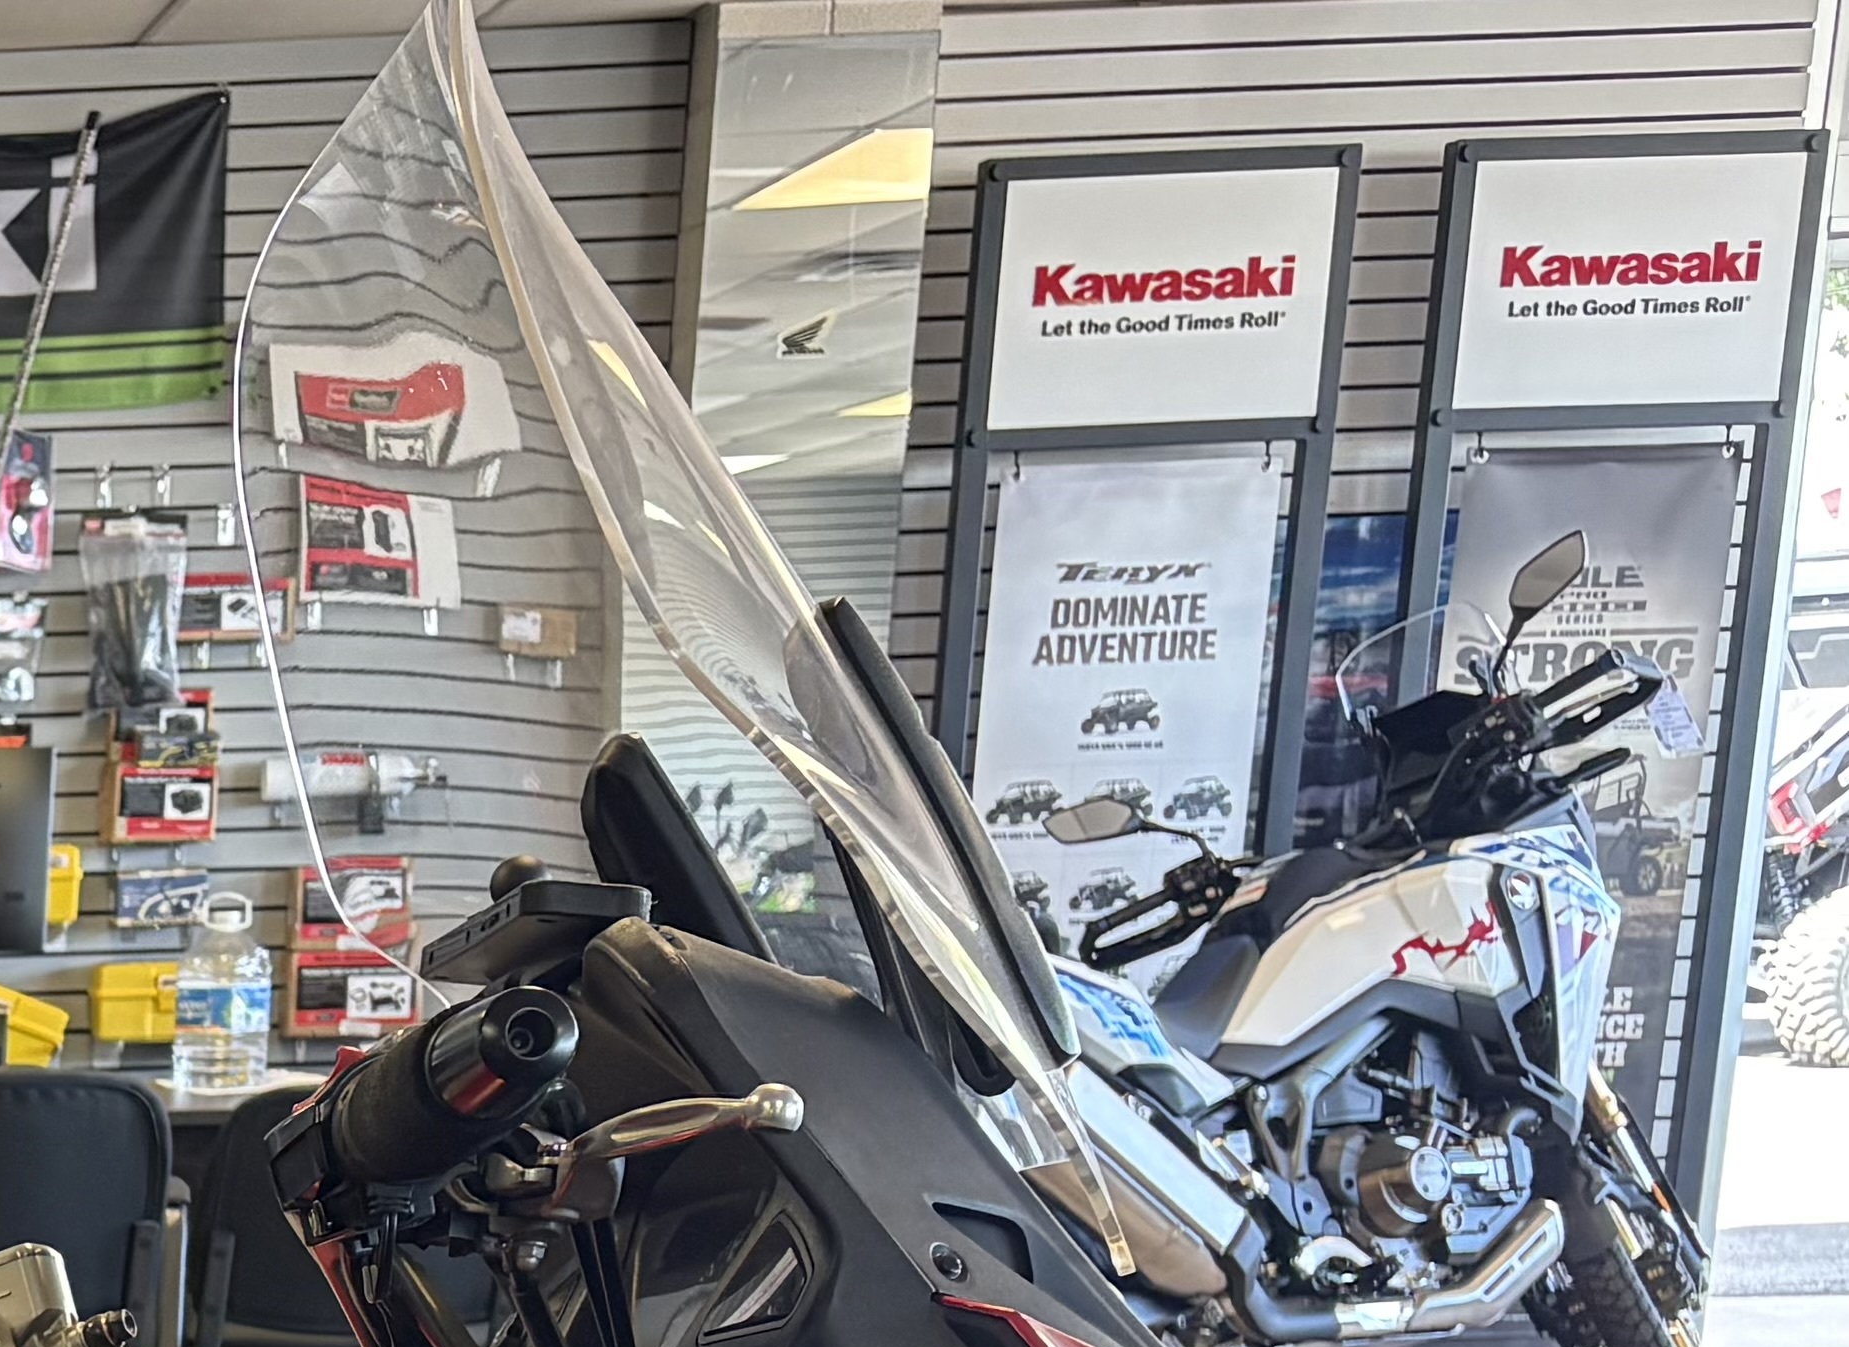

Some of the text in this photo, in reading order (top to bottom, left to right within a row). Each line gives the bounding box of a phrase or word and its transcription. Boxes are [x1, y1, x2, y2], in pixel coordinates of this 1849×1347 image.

[1032, 255, 1295, 307] Kawasaki
[1500, 240, 1762, 288] Kawasaki
[1041, 320, 1073, 337] Let
[1079, 318, 1111, 335] the
[1116, 315, 1170, 333] Good
[1175, 313, 1235, 332] Times
[1508, 301, 1539, 317] Let
[1547, 299, 1578, 316] the
[1583, 298, 1636, 315] Good
[1641, 297, 1700, 314] Times
[1051, 593, 1208, 629] DOMINATE
[1031, 628, 1218, 666] ADVENTURE
